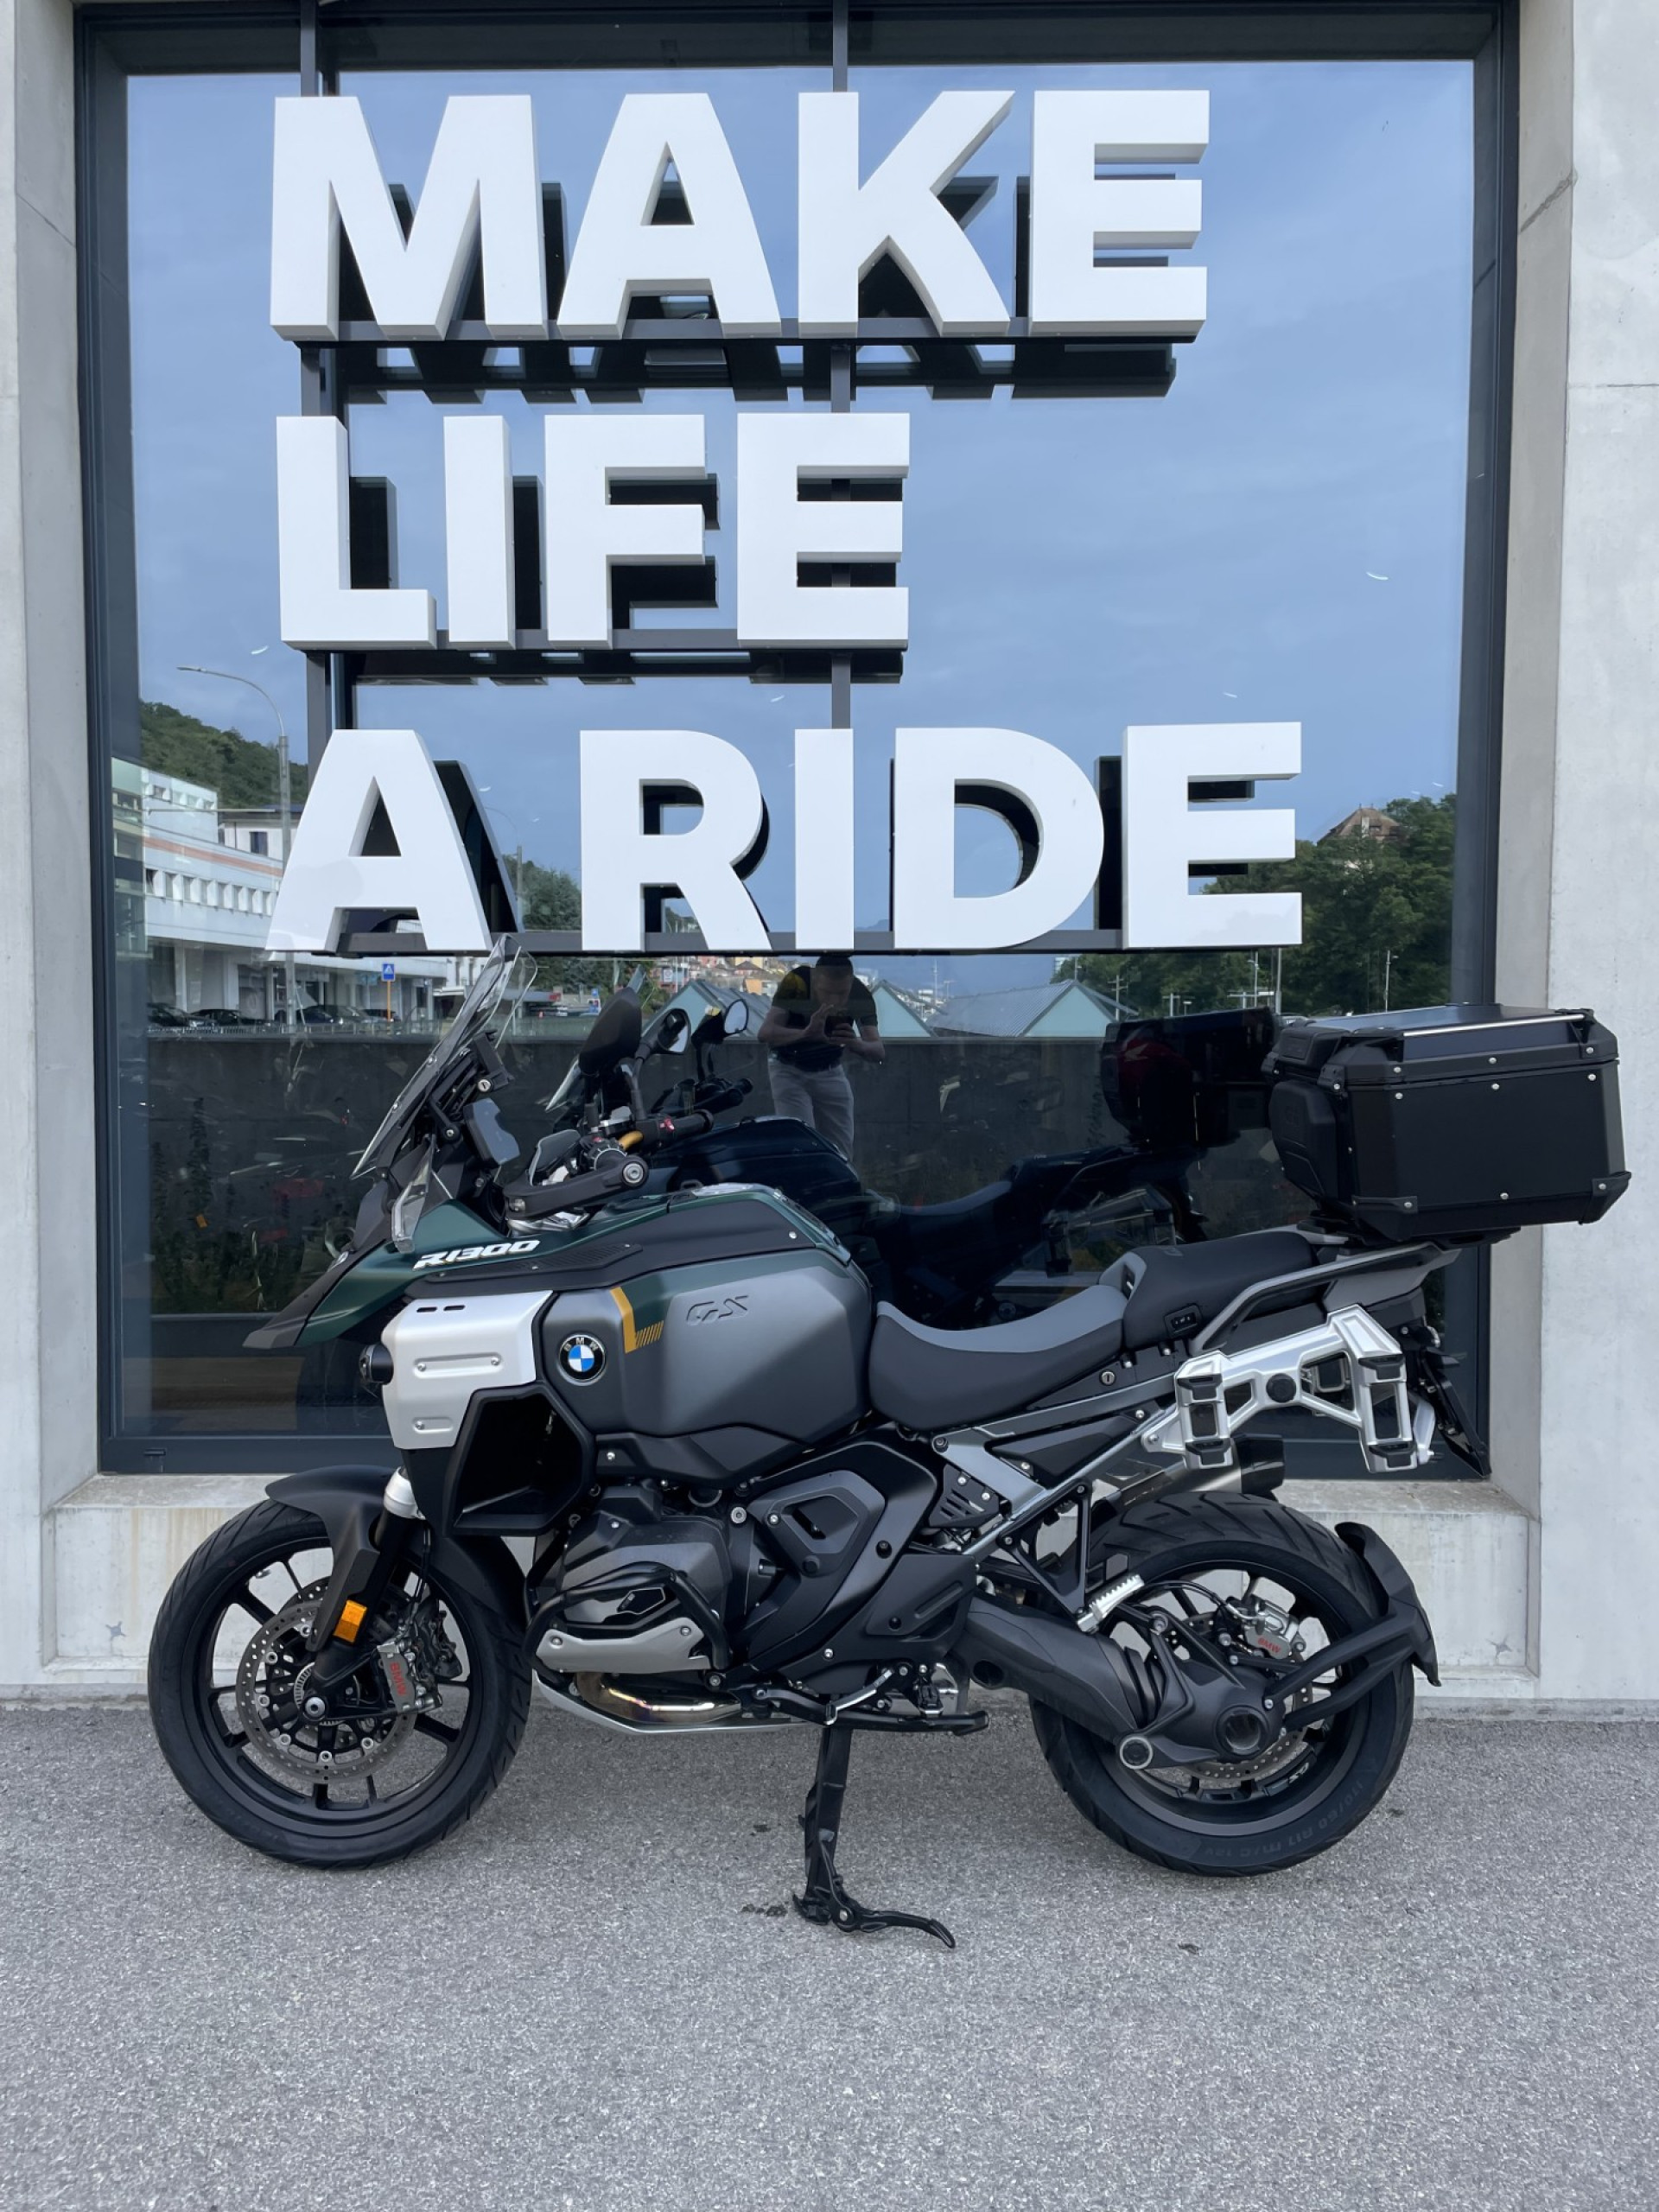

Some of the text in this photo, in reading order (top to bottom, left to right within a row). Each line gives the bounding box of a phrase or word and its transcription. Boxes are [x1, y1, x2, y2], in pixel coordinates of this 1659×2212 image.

[270, 90, 1210, 337] MAKE
[276, 413, 911, 648] LIFE
[266, 721, 1303, 954] A RIDE
[685, 1294, 749, 1326] GS
[1257, 1637, 1281, 1653] BMW
[391, 1662, 407, 1695] BMW
[1287, 1826, 1313, 1847] R17
